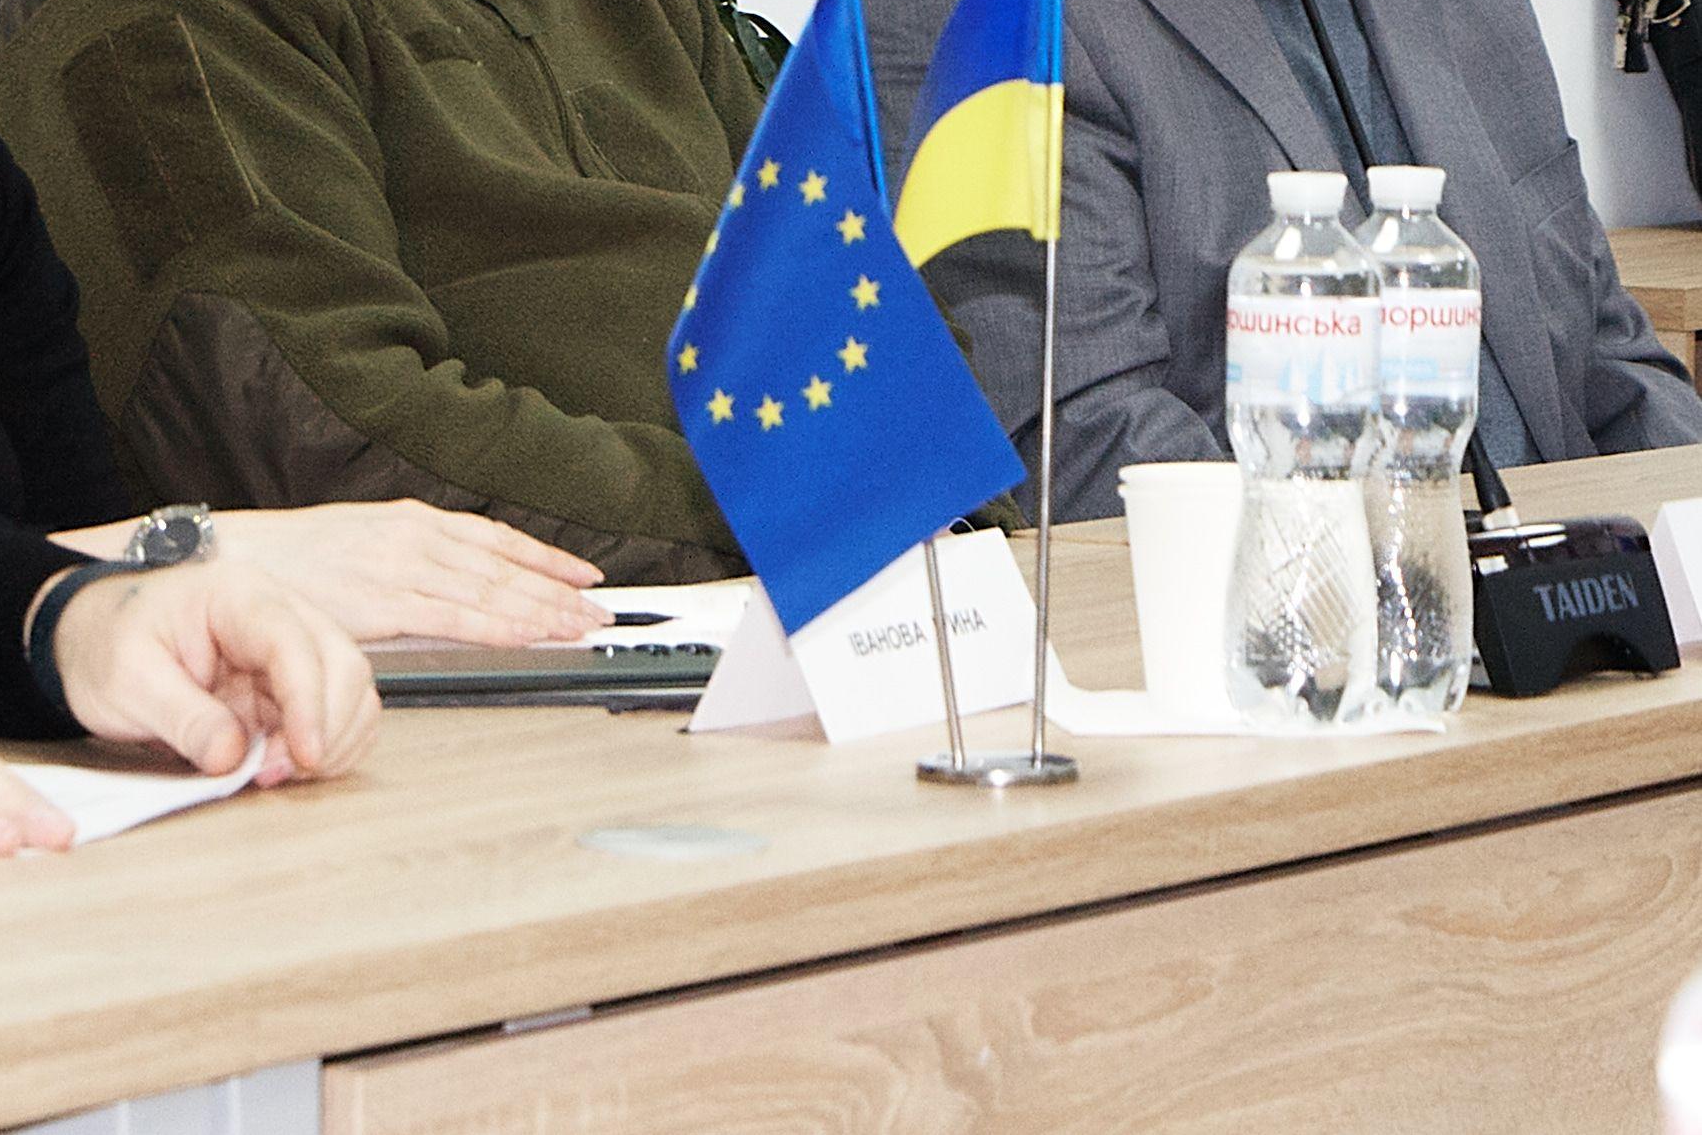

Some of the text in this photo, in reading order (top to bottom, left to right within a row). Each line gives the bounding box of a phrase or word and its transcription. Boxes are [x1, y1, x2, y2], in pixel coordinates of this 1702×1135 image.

[1533, 572, 1639, 622] TAIDEN
[850, 608, 987, 656] ІВАНОВА ИНА
